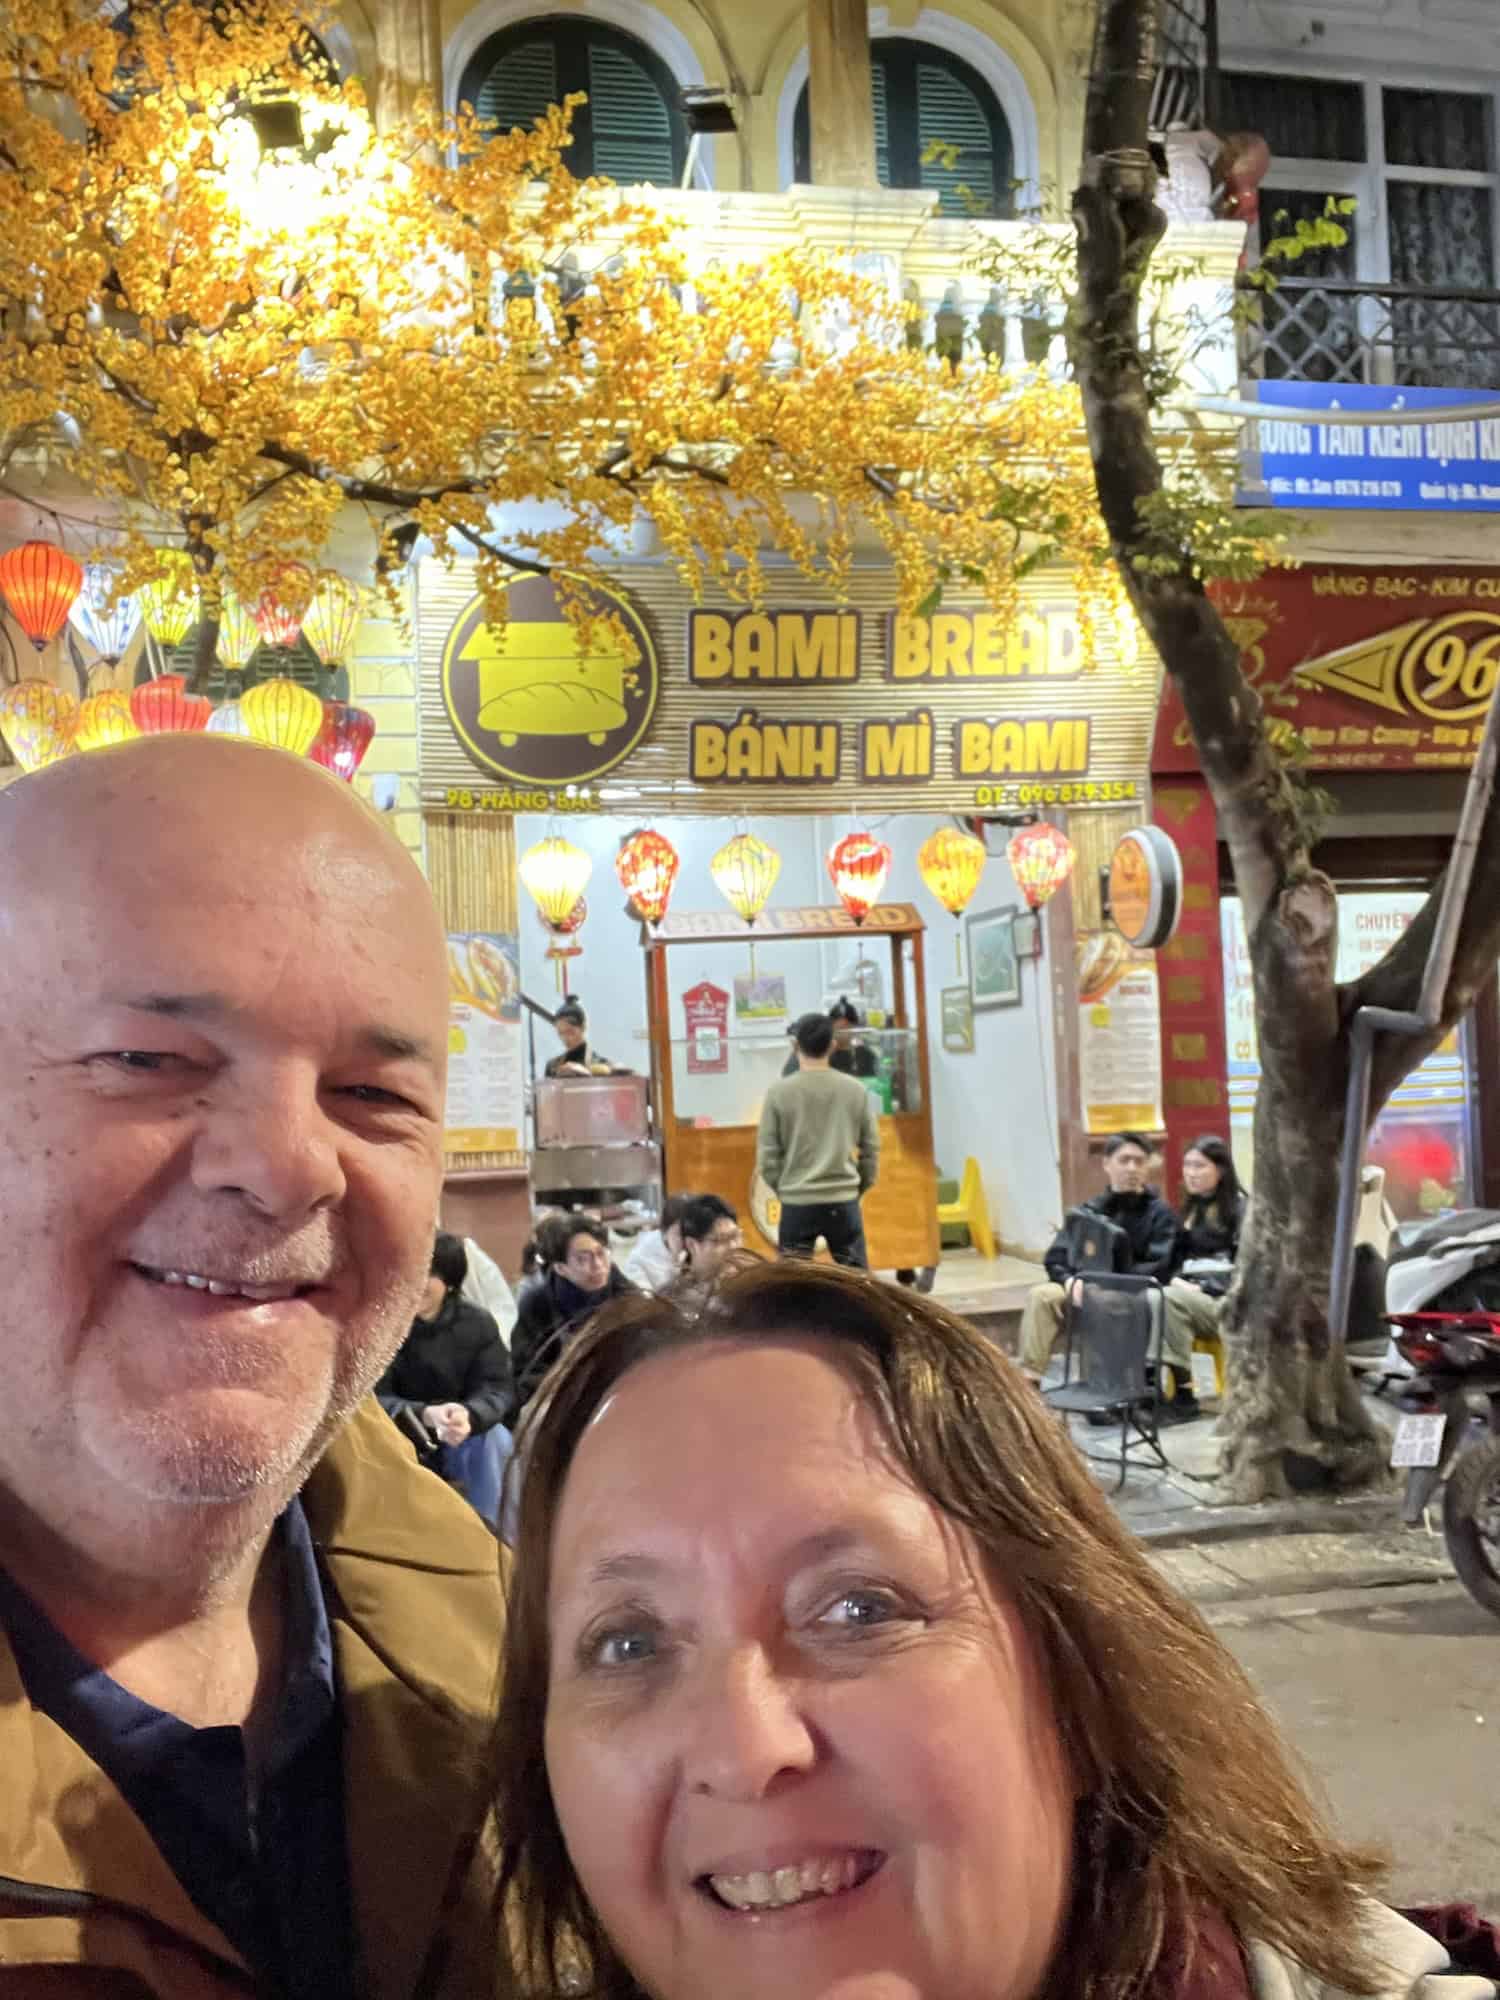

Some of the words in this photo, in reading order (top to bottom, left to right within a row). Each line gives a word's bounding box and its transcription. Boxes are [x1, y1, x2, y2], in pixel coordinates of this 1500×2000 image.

[892, 612, 1085, 678] BREAD
[1421, 634, 1500, 700] 96
[694, 712, 838, 778] BÁNH
[864, 711, 932, 777] MÌ
[960, 718, 1090, 775] BAMI
[447, 788, 473, 809] 98
[481, 785, 549, 810] HÀNG
